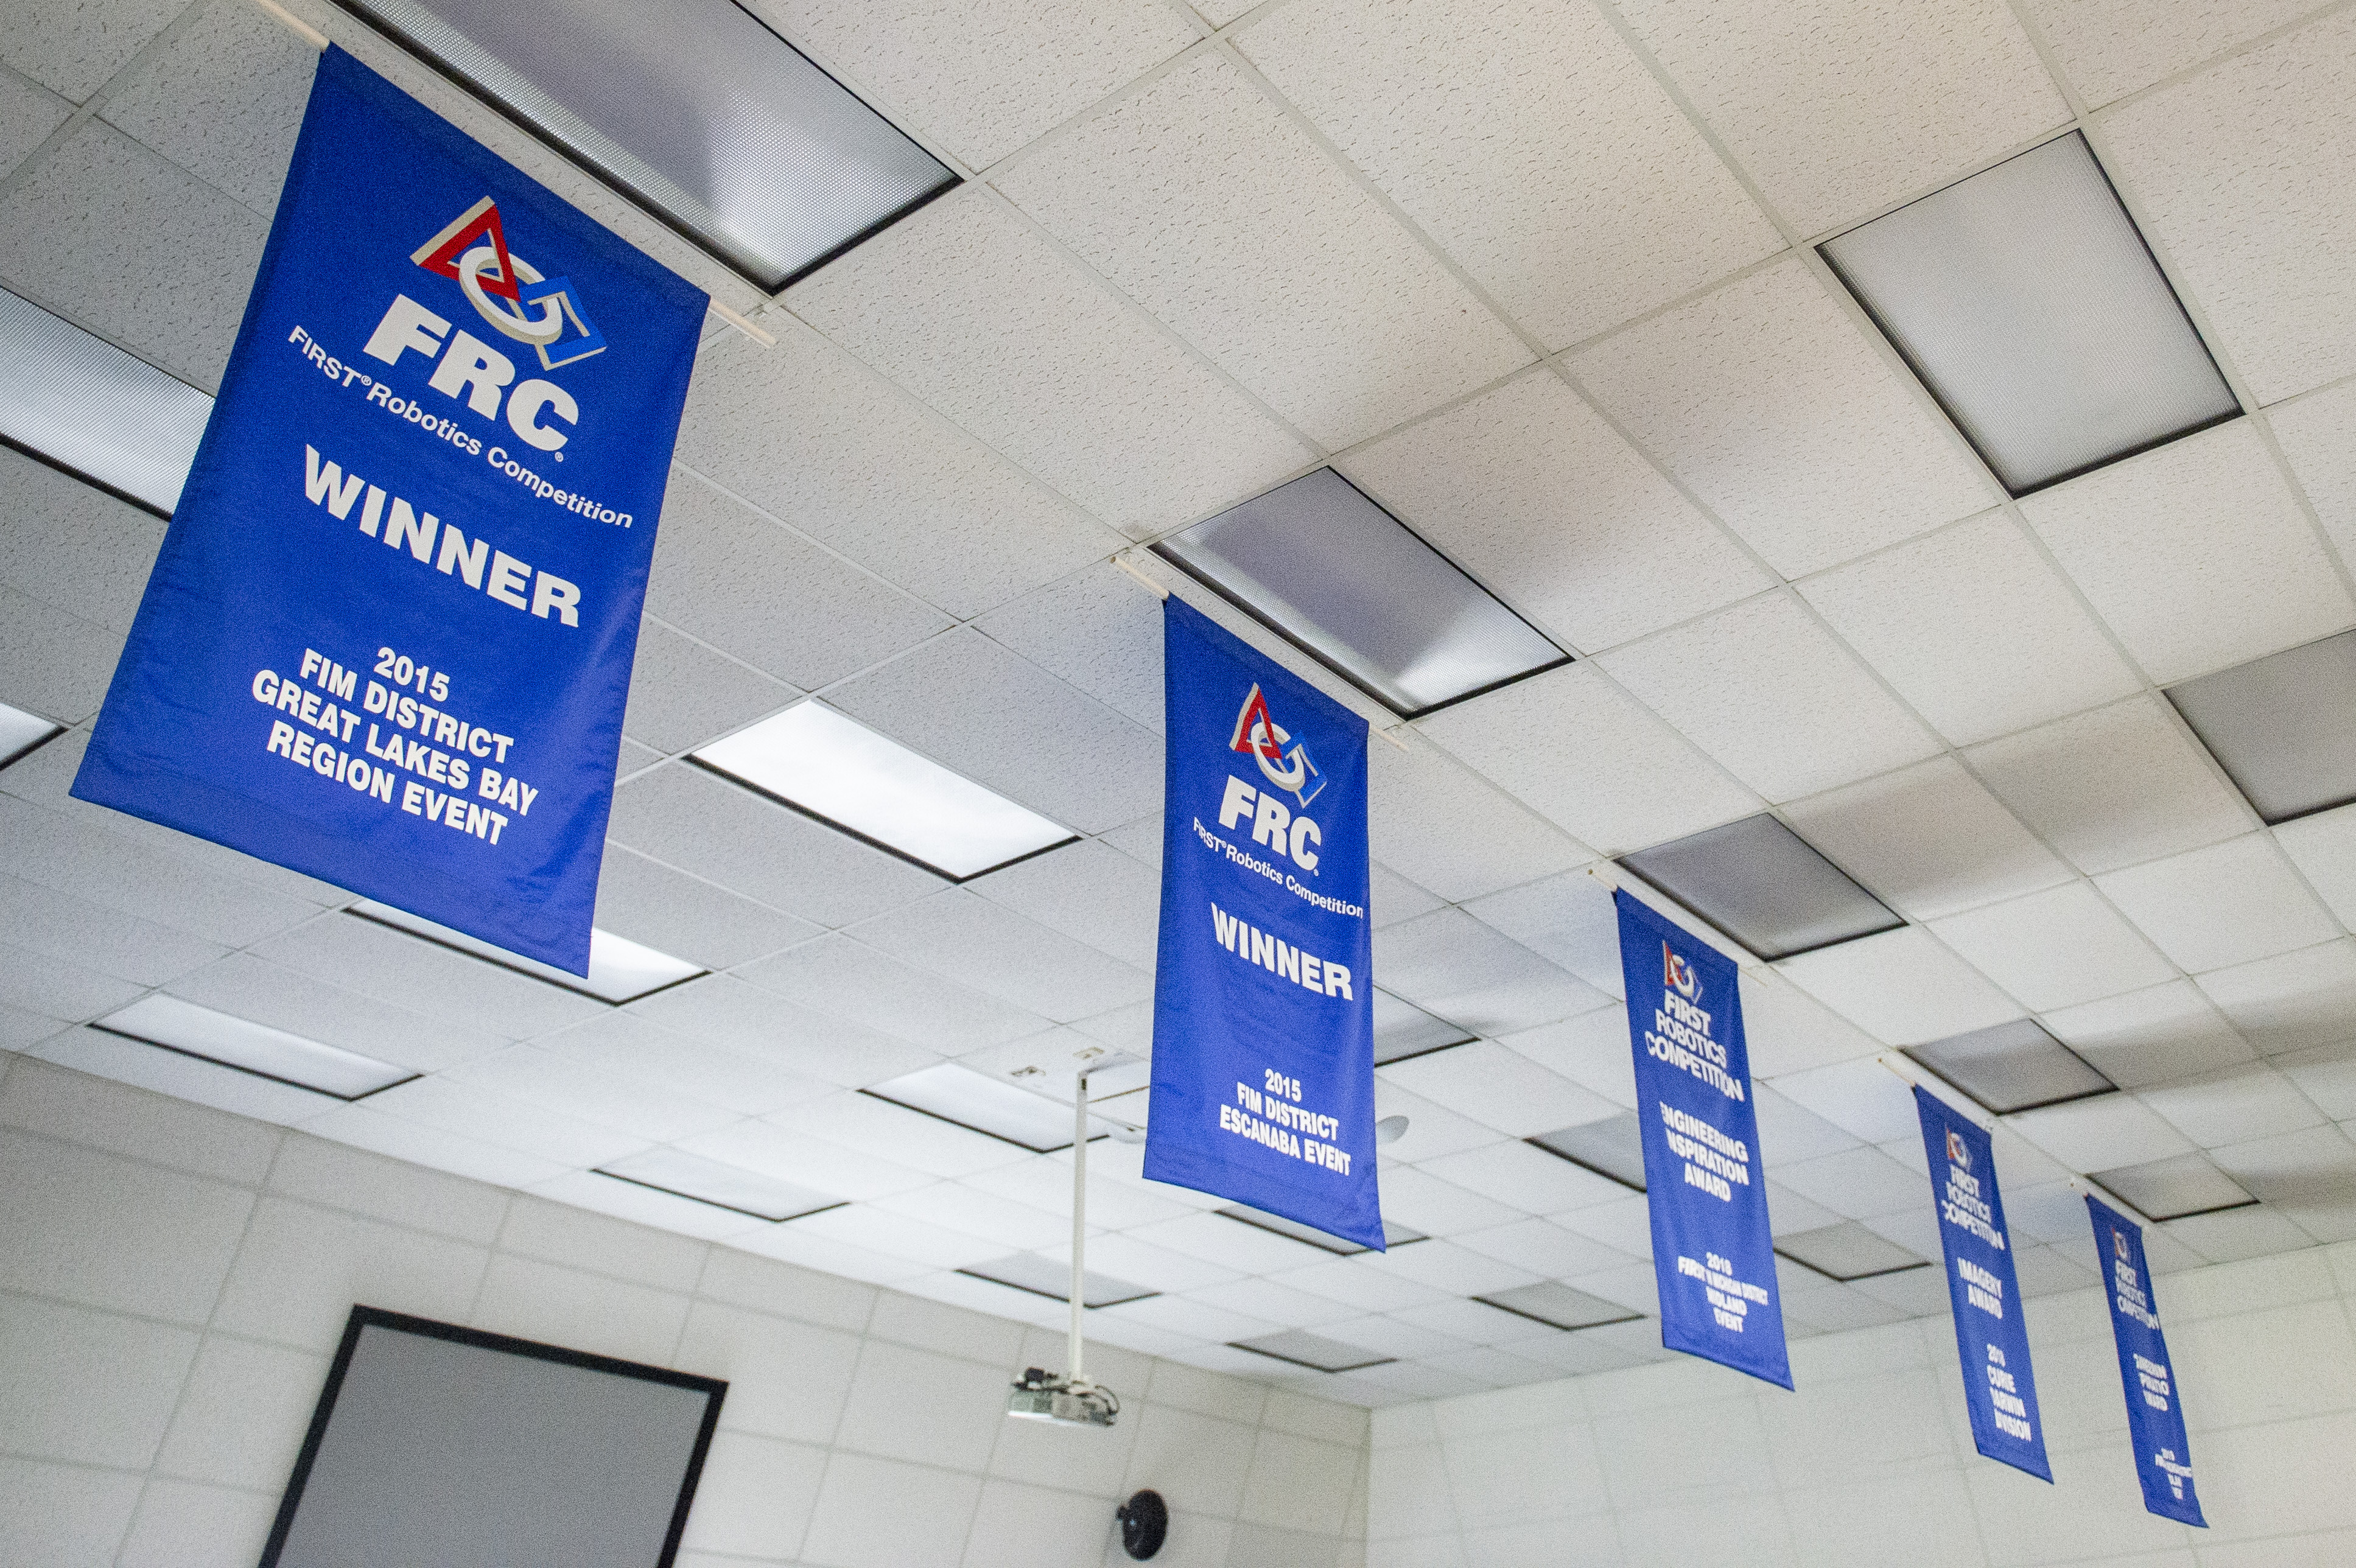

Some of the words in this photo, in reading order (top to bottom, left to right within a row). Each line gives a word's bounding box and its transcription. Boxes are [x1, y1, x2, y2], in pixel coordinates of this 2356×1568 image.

[367, 383, 481, 454] Robotics
[488, 447, 632, 527] Competition
[306, 445, 580, 627] WINNER
[300, 649, 357, 701] FIM
[363, 681, 513, 763] DISTRICT
[374, 648, 449, 701] 2015
[253, 670, 360, 742] GREAT
[366, 724, 469, 789] LAKES
[479, 768, 538, 816] BAY
[267, 720, 394, 803] REGION
[402, 781, 508, 845] EVENT
[1227, 845, 1282, 884] Robotics
[1286, 875, 1362, 918] Competition
[1211, 903, 1353, 1000] WINNER
[1656, 1010, 1726, 1068] ROBOTICS
[1665, 990, 1710, 1035] FIRST
[1265, 1069, 1302, 1102] 2015
[1646, 1032, 1744, 1101] COMPETITION
[1220, 1104, 1301, 1158] ESCANABA
[1304, 1139, 1351, 1175] EVENT
[1237, 1082, 1262, 1115] FIM
[1266, 1096, 1339, 1141] DISTRICT
[1685, 1163, 1731, 1202] AWARD
